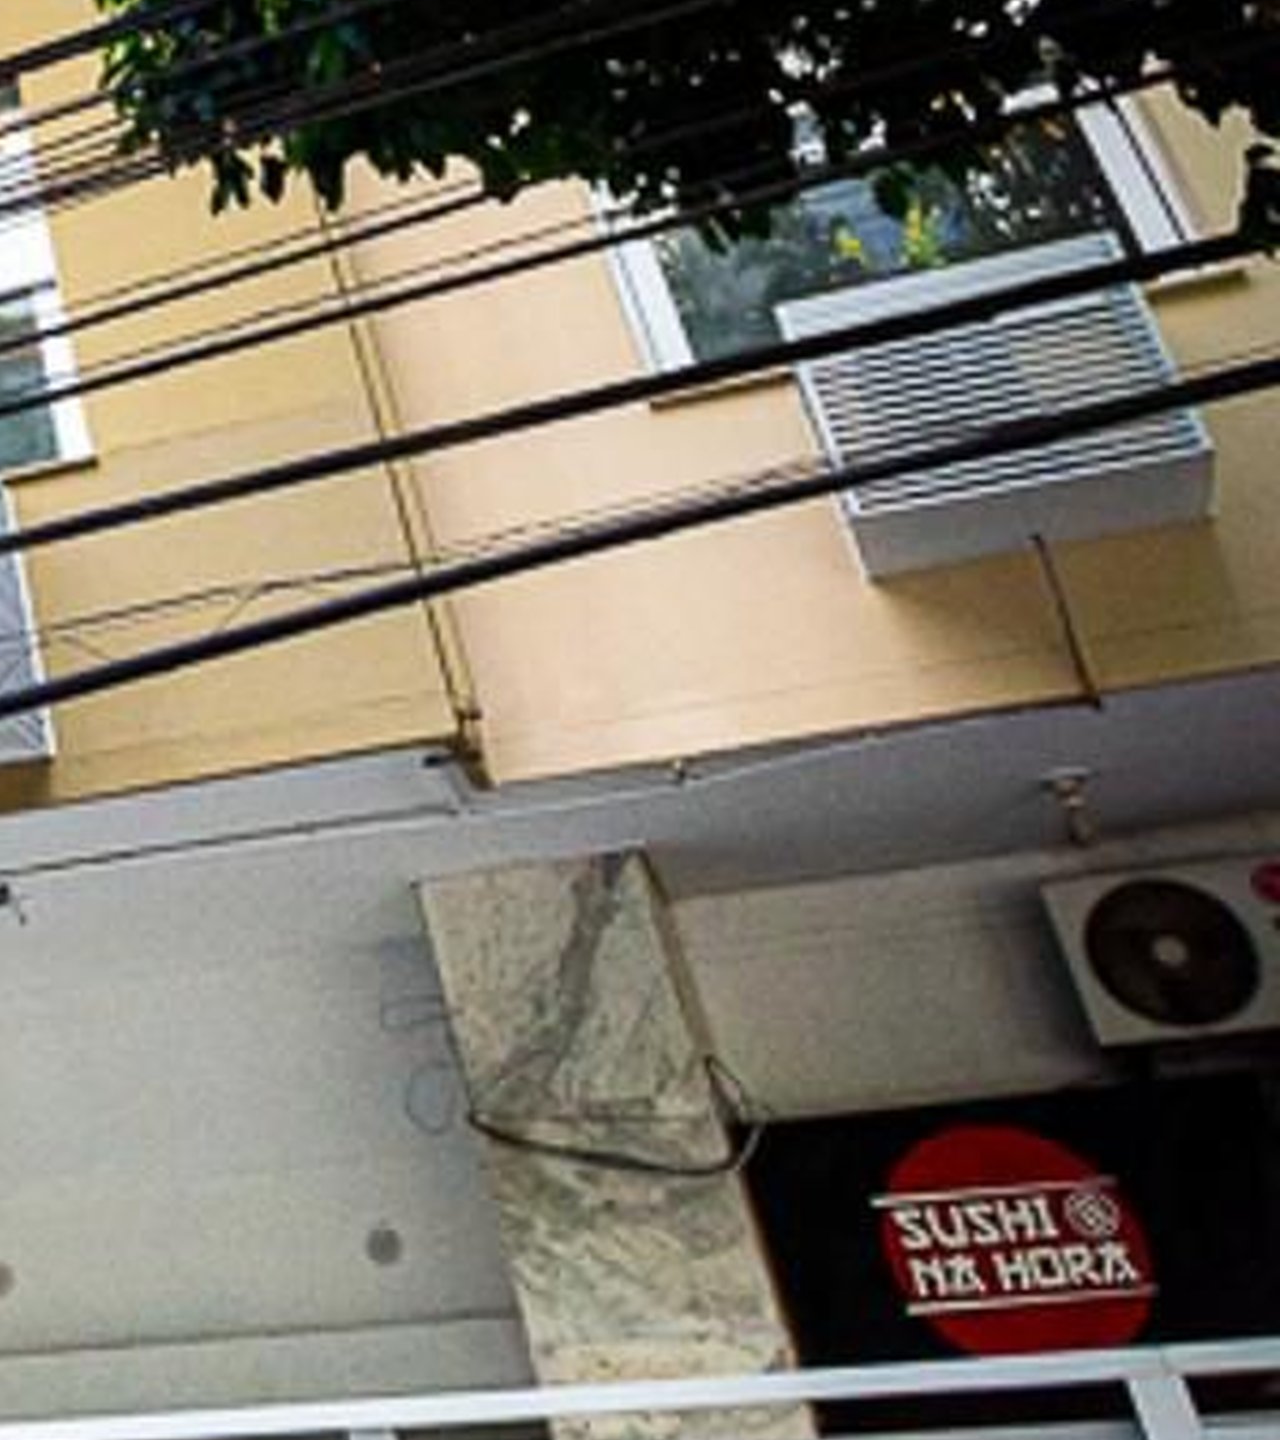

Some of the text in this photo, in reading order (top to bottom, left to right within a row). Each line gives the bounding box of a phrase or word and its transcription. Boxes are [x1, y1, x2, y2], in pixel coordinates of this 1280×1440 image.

[892, 1197, 1060, 1250] SUSHI
[907, 1239, 1140, 1297] NA HORA
